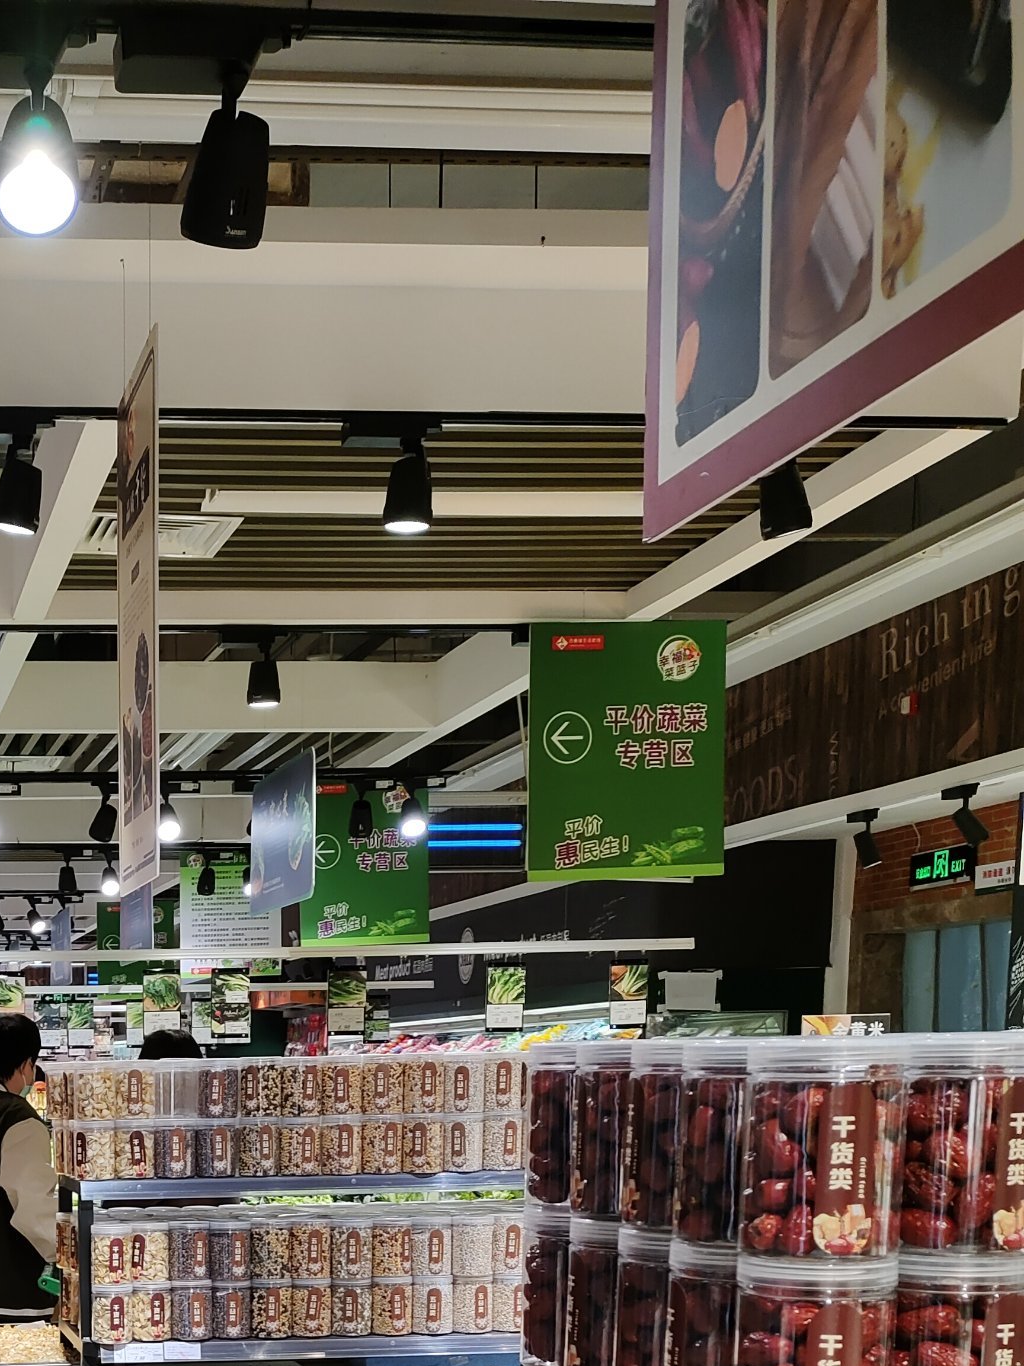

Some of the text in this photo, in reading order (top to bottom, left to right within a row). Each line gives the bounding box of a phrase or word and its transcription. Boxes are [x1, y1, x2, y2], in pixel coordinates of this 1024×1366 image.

[879, 601, 950, 681] Rich
[604, 703, 708, 735] 平价蔬菜
[616, 740, 694, 769] 专营区
[564, 815, 603, 839] 平价
[355, 852, 409, 871] 专营区
[951, 859, 967, 873] EXIT
[324, 903, 349, 919] 平价
[828, 1115, 856, 1191] 干货类
[859, 1156, 867, 1177] dried
